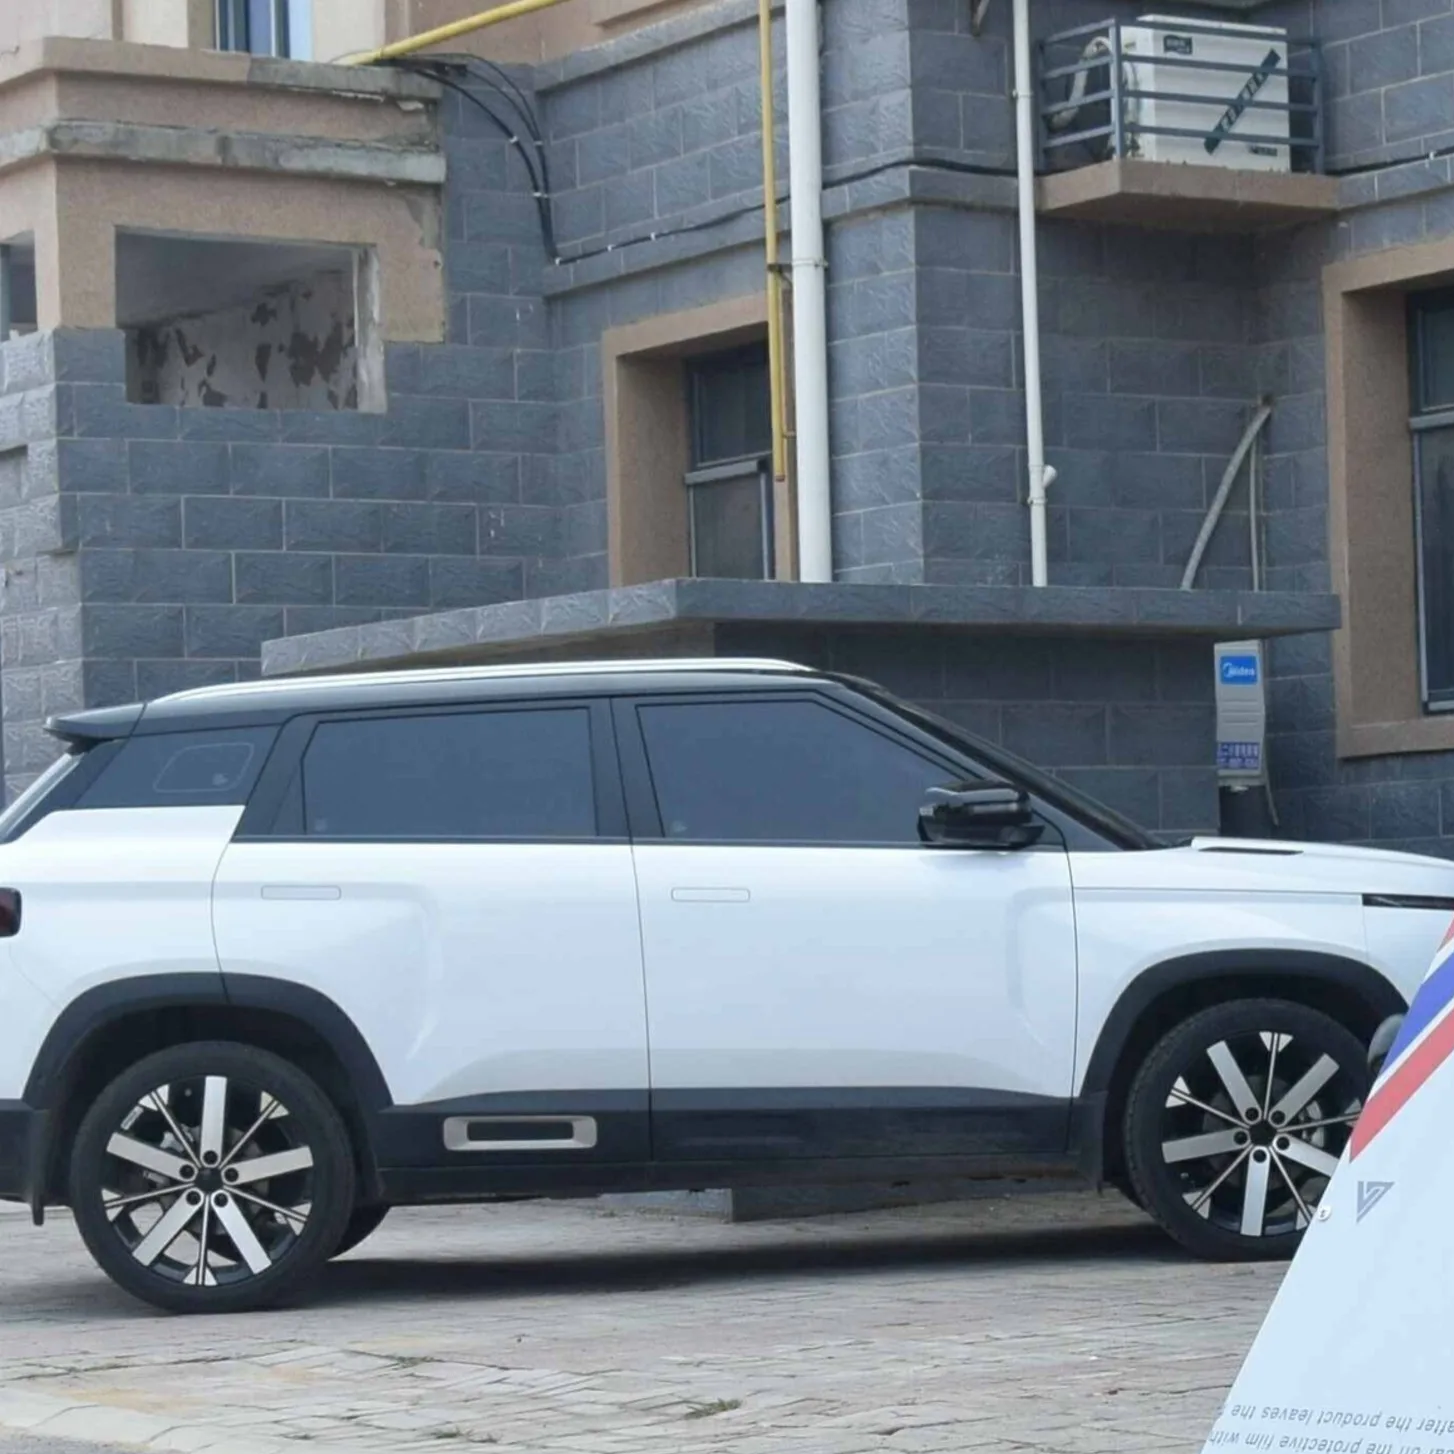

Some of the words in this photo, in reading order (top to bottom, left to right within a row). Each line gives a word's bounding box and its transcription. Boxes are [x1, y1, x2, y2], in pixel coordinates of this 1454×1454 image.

[1231, 1404, 1256, 1420] the
[1261, 1406, 1313, 1425] leaves
[1317, 1409, 1382, 1428] product
[1385, 1415, 1412, 1432] the
[1245, 1432, 1275, 1450] film
[1279, 1435, 1363, 1454] protective
